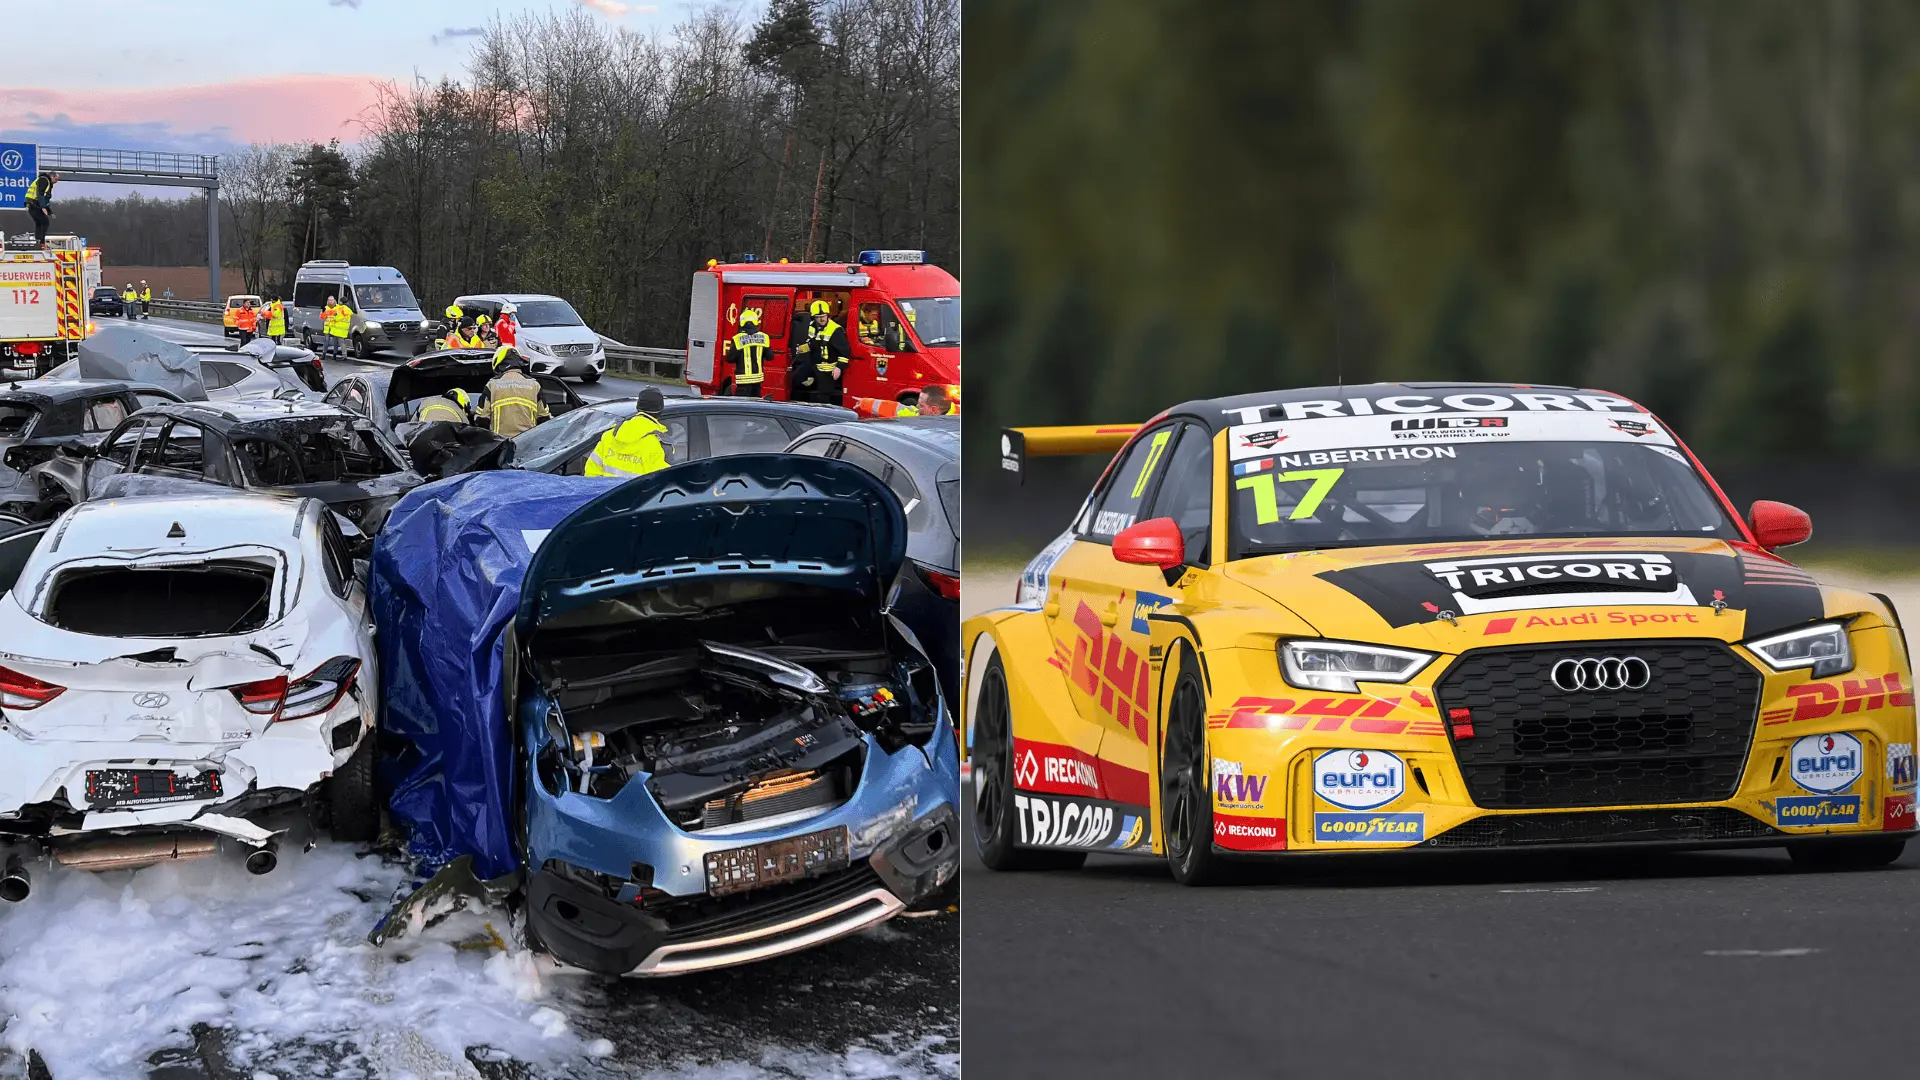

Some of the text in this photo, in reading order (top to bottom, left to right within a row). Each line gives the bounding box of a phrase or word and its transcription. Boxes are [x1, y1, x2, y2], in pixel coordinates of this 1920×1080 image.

[5, 154, 19, 166] 67
[882, 253, 920, 262] FEUERWEHR
[12, 289, 39, 305] 112
[1221, 394, 1633, 424] TRICORP
[1131, 431, 1172, 498] 17
[1280, 446, 1457, 468] N.BERTHON
[1236, 468, 1344, 525] 17
[1436, 563, 1673, 590] TRICORP
[1525, 610, 1699, 629] Audi Sport
[1786, 673, 1915, 722] DHL
[1226, 696, 1410, 735] DHL
[1044, 756, 1099, 790] IRECKONU
[1797, 751, 1856, 773] eurol
[1322, 768, 1396, 788] eurol
[1796, 771, 1857, 780] LUBRICANTS
[1218, 773, 1267, 803] KW
[1321, 788, 1397, 796] LUBRICANTS
[126, 797, 160, 806] AUTOTECHNIK
[1015, 794, 1113, 847] TRICORP
[1229, 824, 1277, 838] IRECKONU
